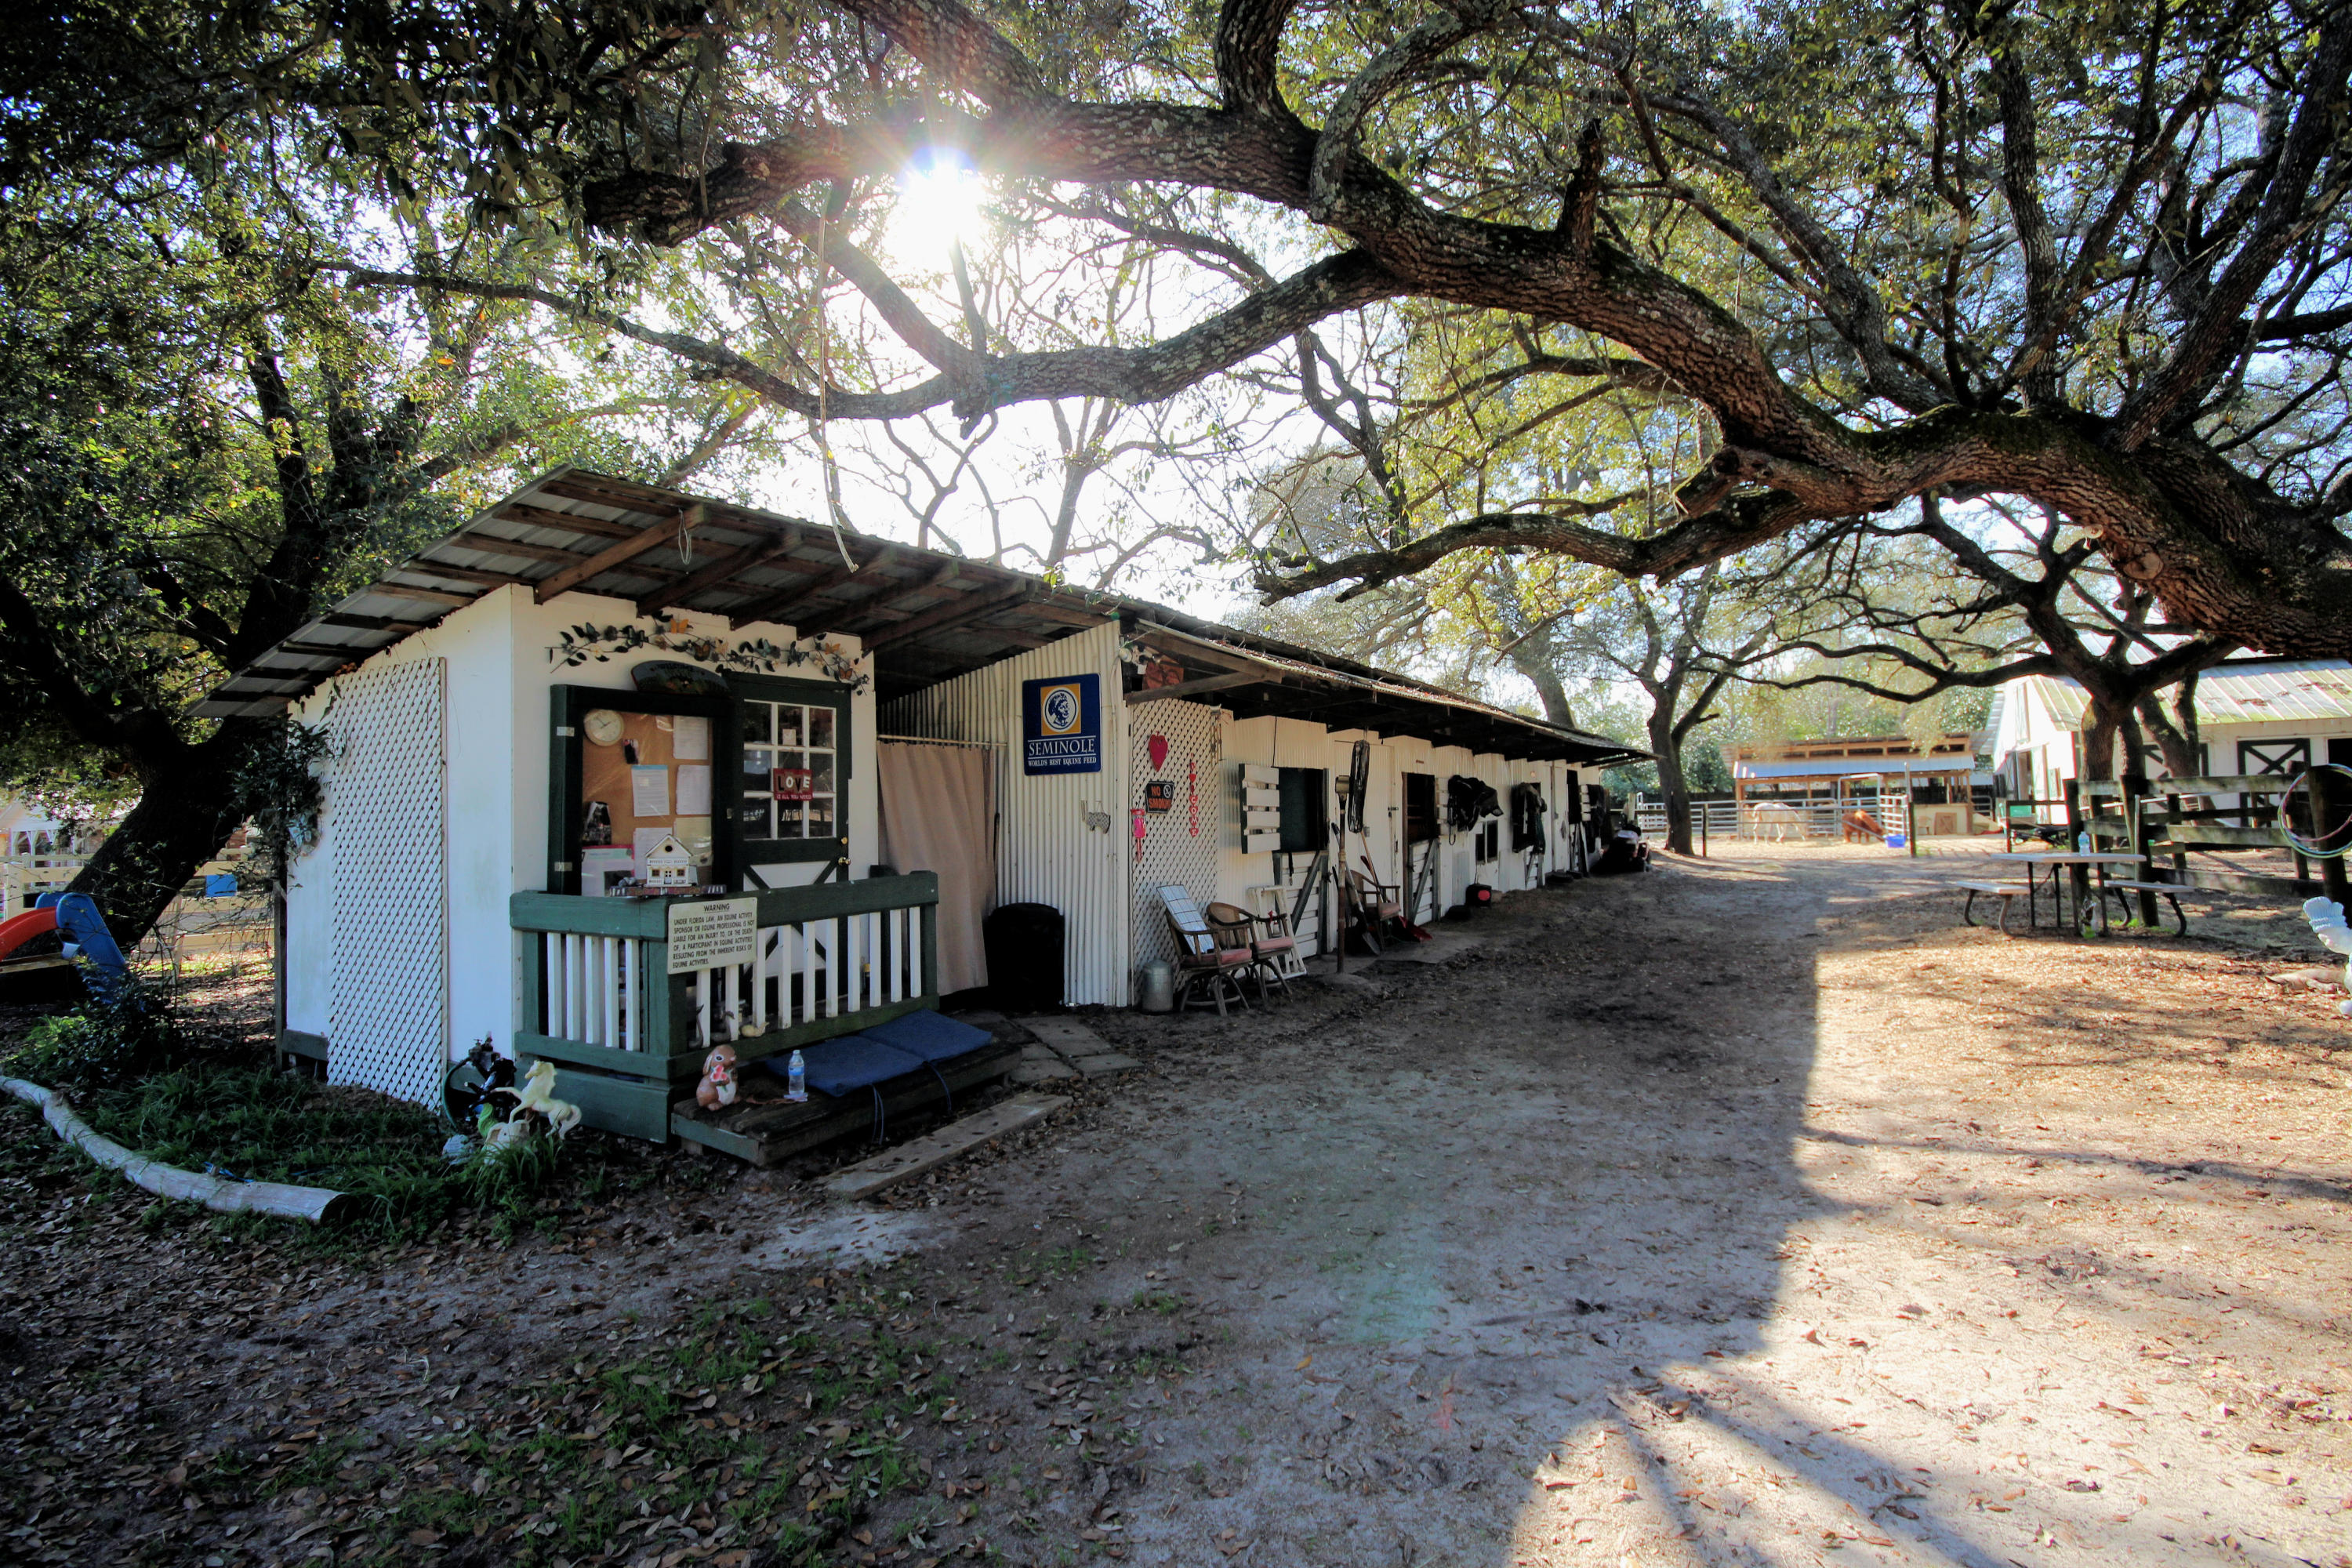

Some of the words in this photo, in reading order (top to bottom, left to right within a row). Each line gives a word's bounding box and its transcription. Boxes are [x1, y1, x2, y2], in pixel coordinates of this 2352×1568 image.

[1029, 739, 1094, 756] SEMINOLE
[1063, 757, 1082, 766] EQUINE
[778, 776, 811, 792] LOVE
[1152, 786, 1160, 797] NO
[704, 903, 730, 912] WARNING
[688, 941, 712, 949] PARTICIPANT
